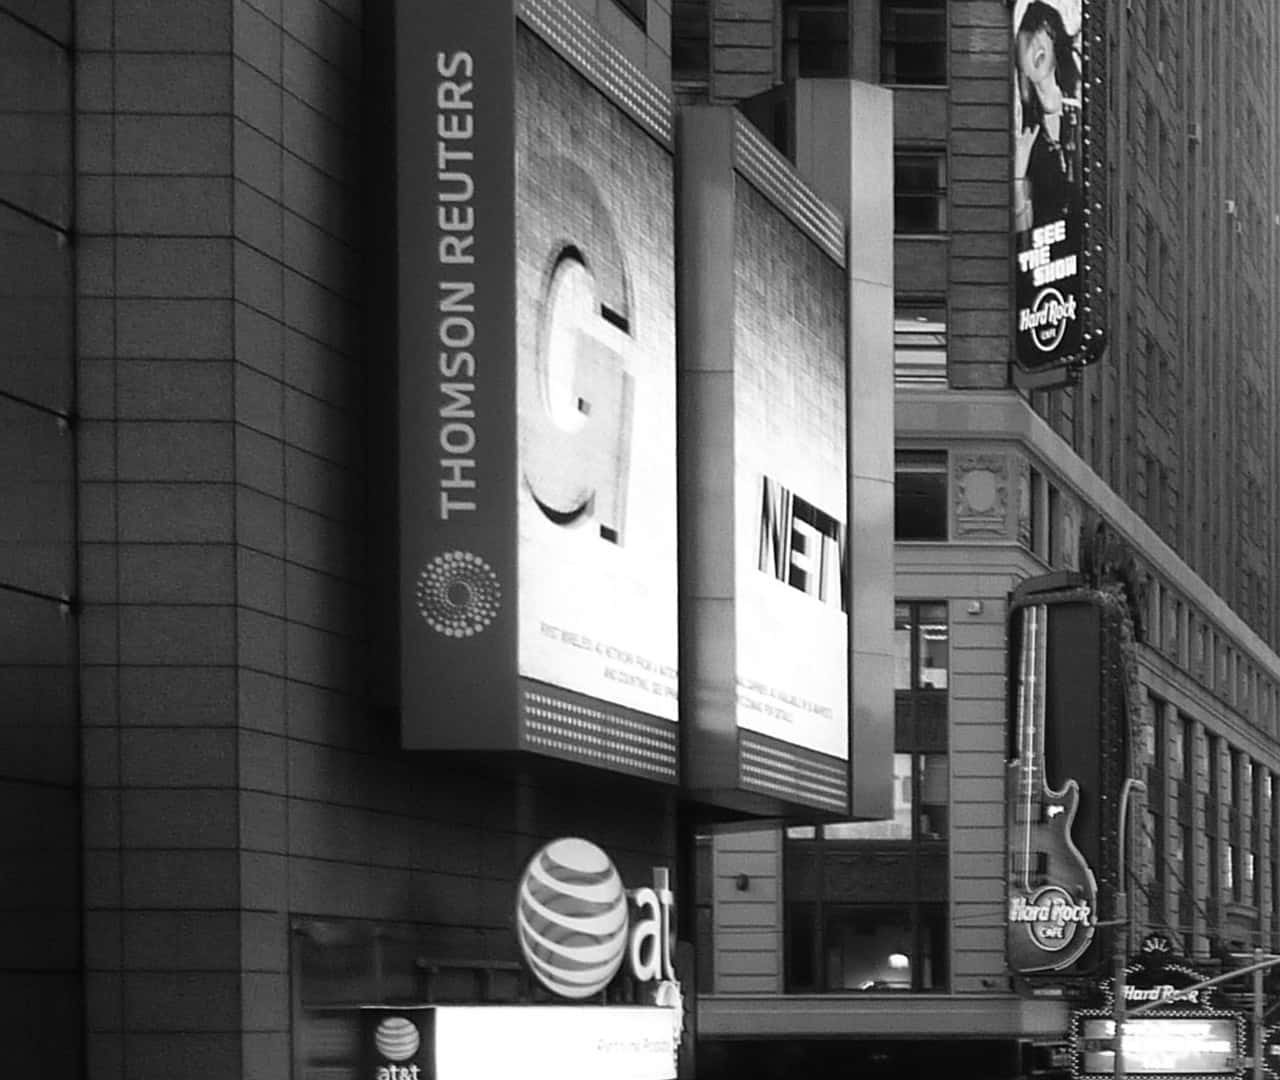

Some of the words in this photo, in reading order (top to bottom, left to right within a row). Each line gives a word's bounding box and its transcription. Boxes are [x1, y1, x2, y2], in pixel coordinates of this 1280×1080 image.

[437, 50, 475, 265] REUTERS
[1032, 220, 1066, 249] SEE
[1018, 244, 1051, 272] THE
[1032, 254, 1077, 287] SHOW
[1019, 302, 1050, 332] Hard
[1049, 294, 1077, 326] Rock
[439, 281, 477, 520] THOMSON
[1009, 896, 1052, 923] Hard
[1050, 896, 1092, 927] Rock
[1038, 926, 1065, 939] CAFE
[1120, 984, 1161, 1001] Hard
